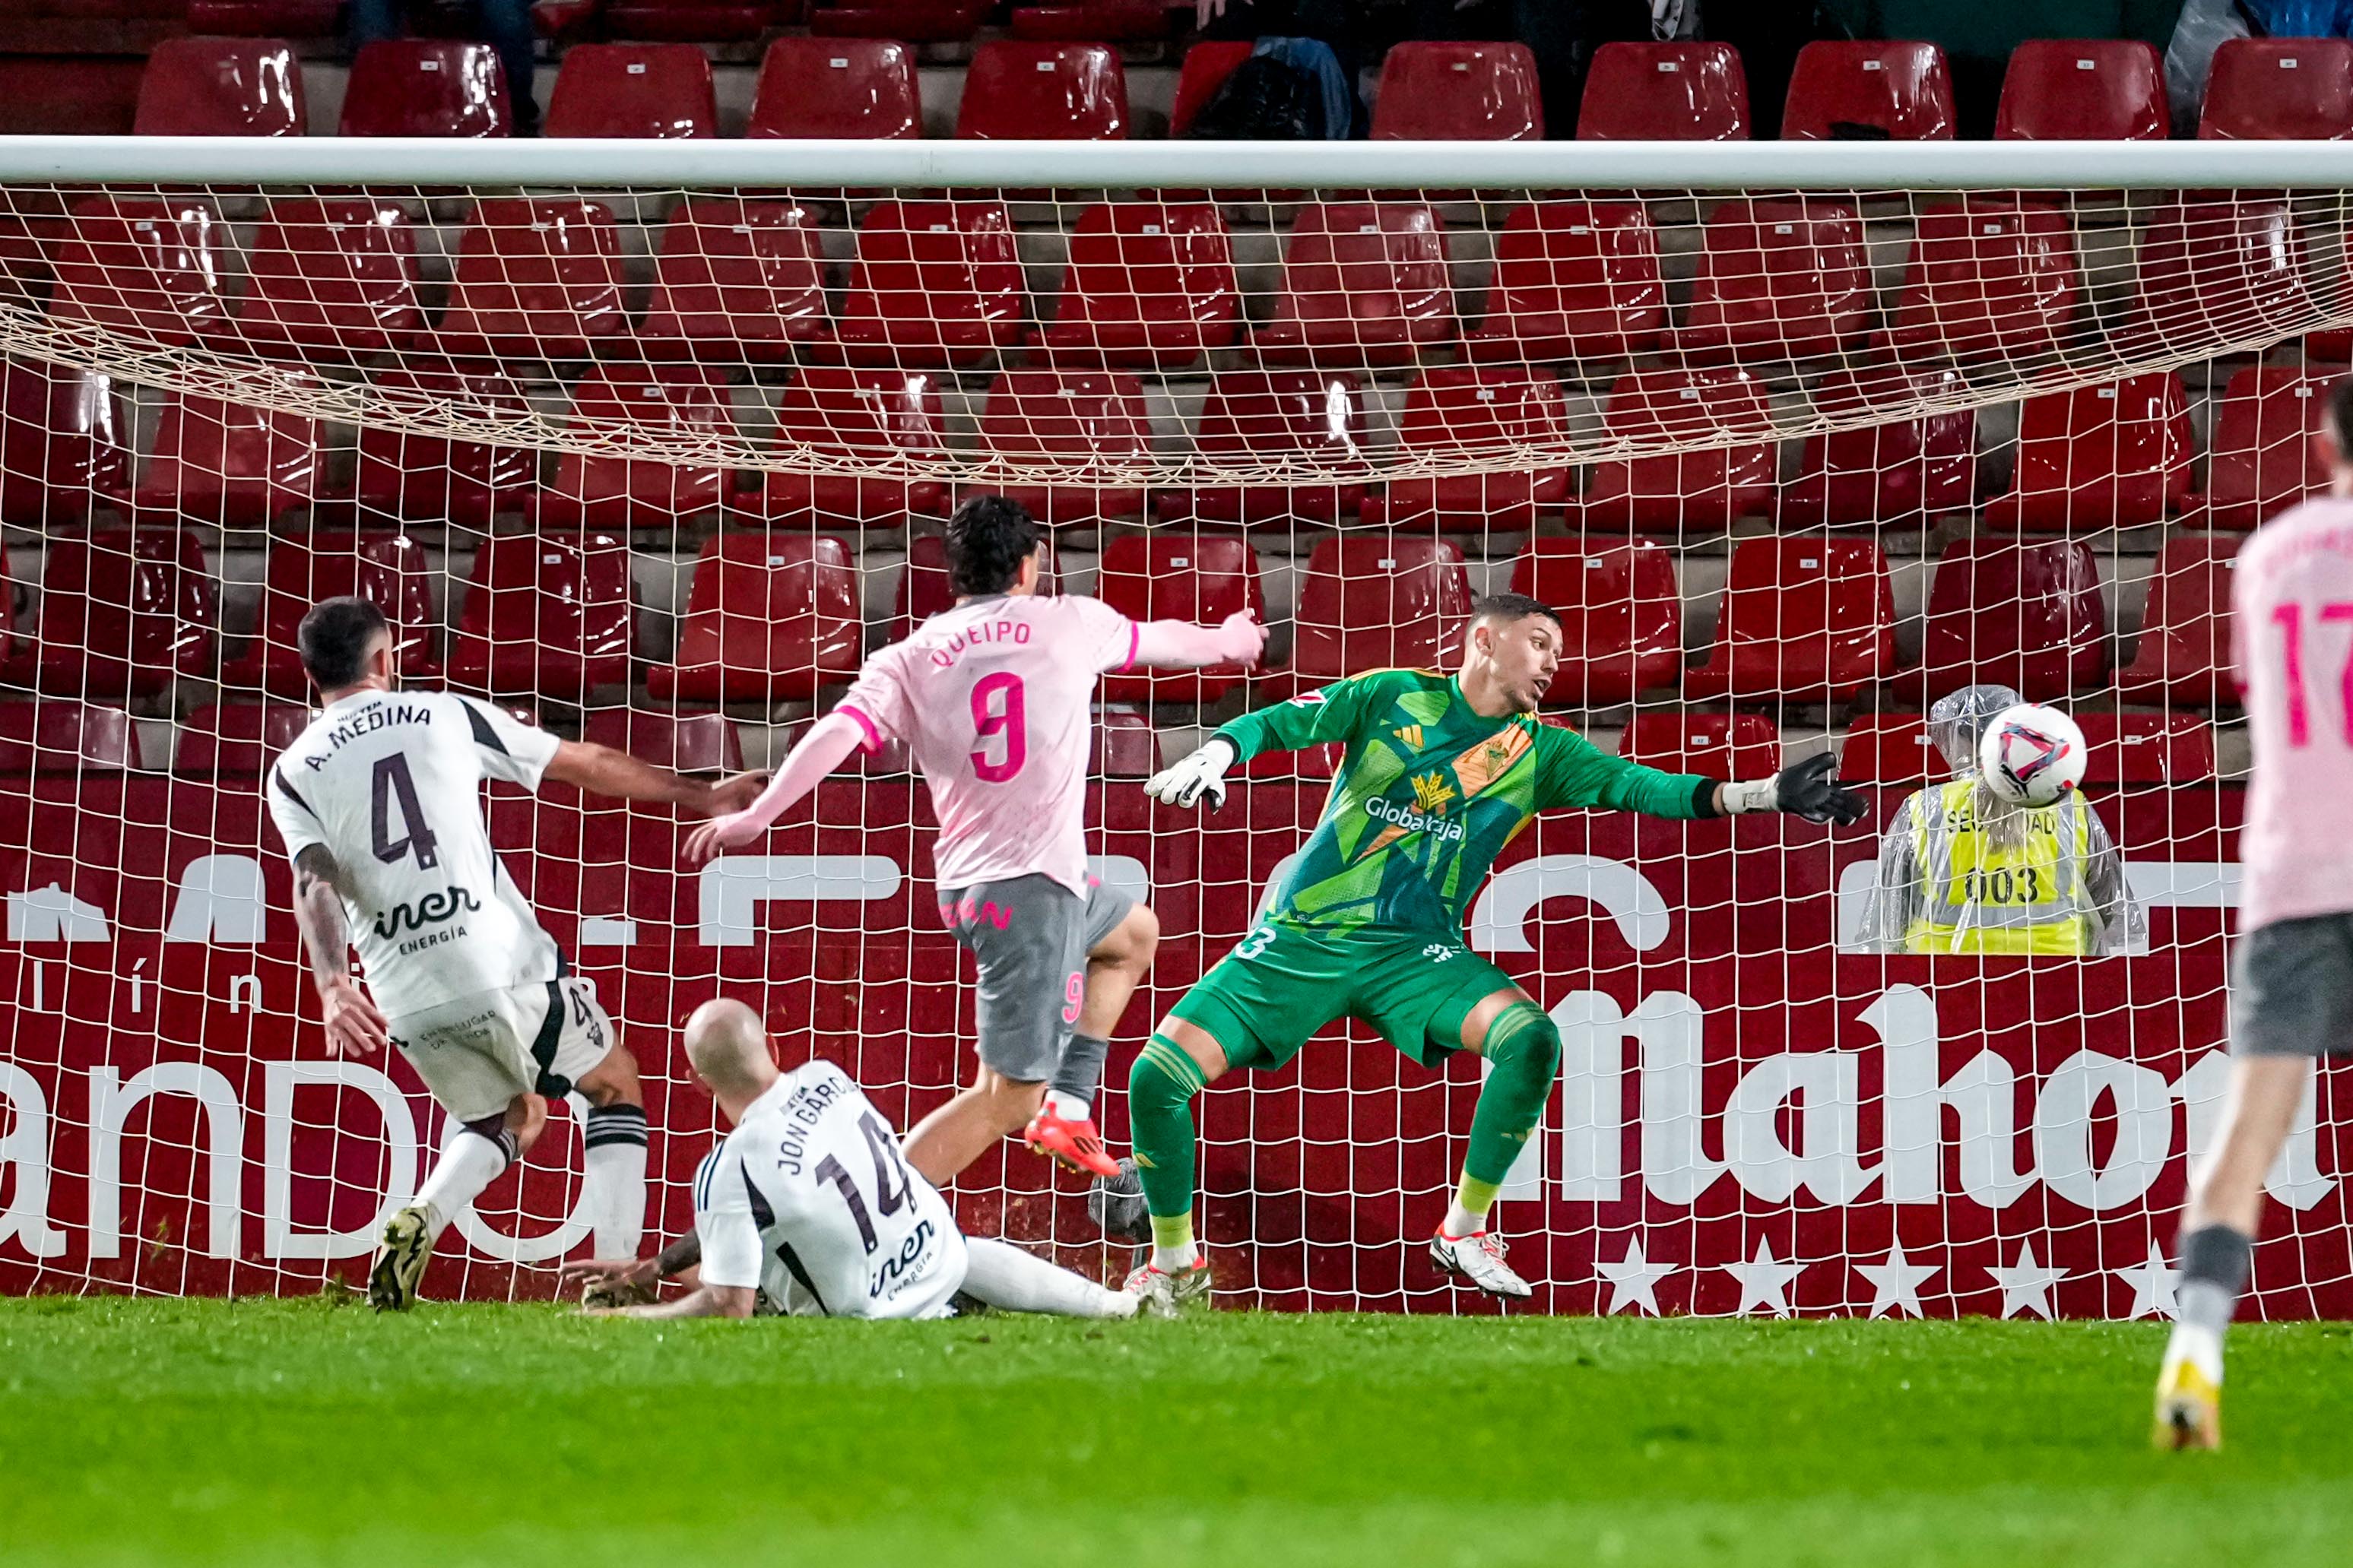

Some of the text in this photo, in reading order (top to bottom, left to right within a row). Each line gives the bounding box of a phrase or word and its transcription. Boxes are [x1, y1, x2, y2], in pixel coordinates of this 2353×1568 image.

[931, 620, 1032, 667] QUEIPO
[304, 752, 332, 772] A.
[328, 705, 431, 750] MEDINA
[969, 671, 1027, 784] 9
[371, 751, 438, 871] 4
[1364, 796, 1464, 841] Globalcaja
[373, 885, 481, 940] iner
[1964, 866, 2039, 904] 003
[398, 924, 468, 955] ENERGÍA
[1061, 971, 1083, 1024] 9
[777, 1122, 809, 1176] JON
[795, 1075, 855, 1126] GARC
[1479, 983, 2339, 1212] Mahou
[814, 1109, 918, 1257] 14
[869, 1218, 935, 1300] iner
